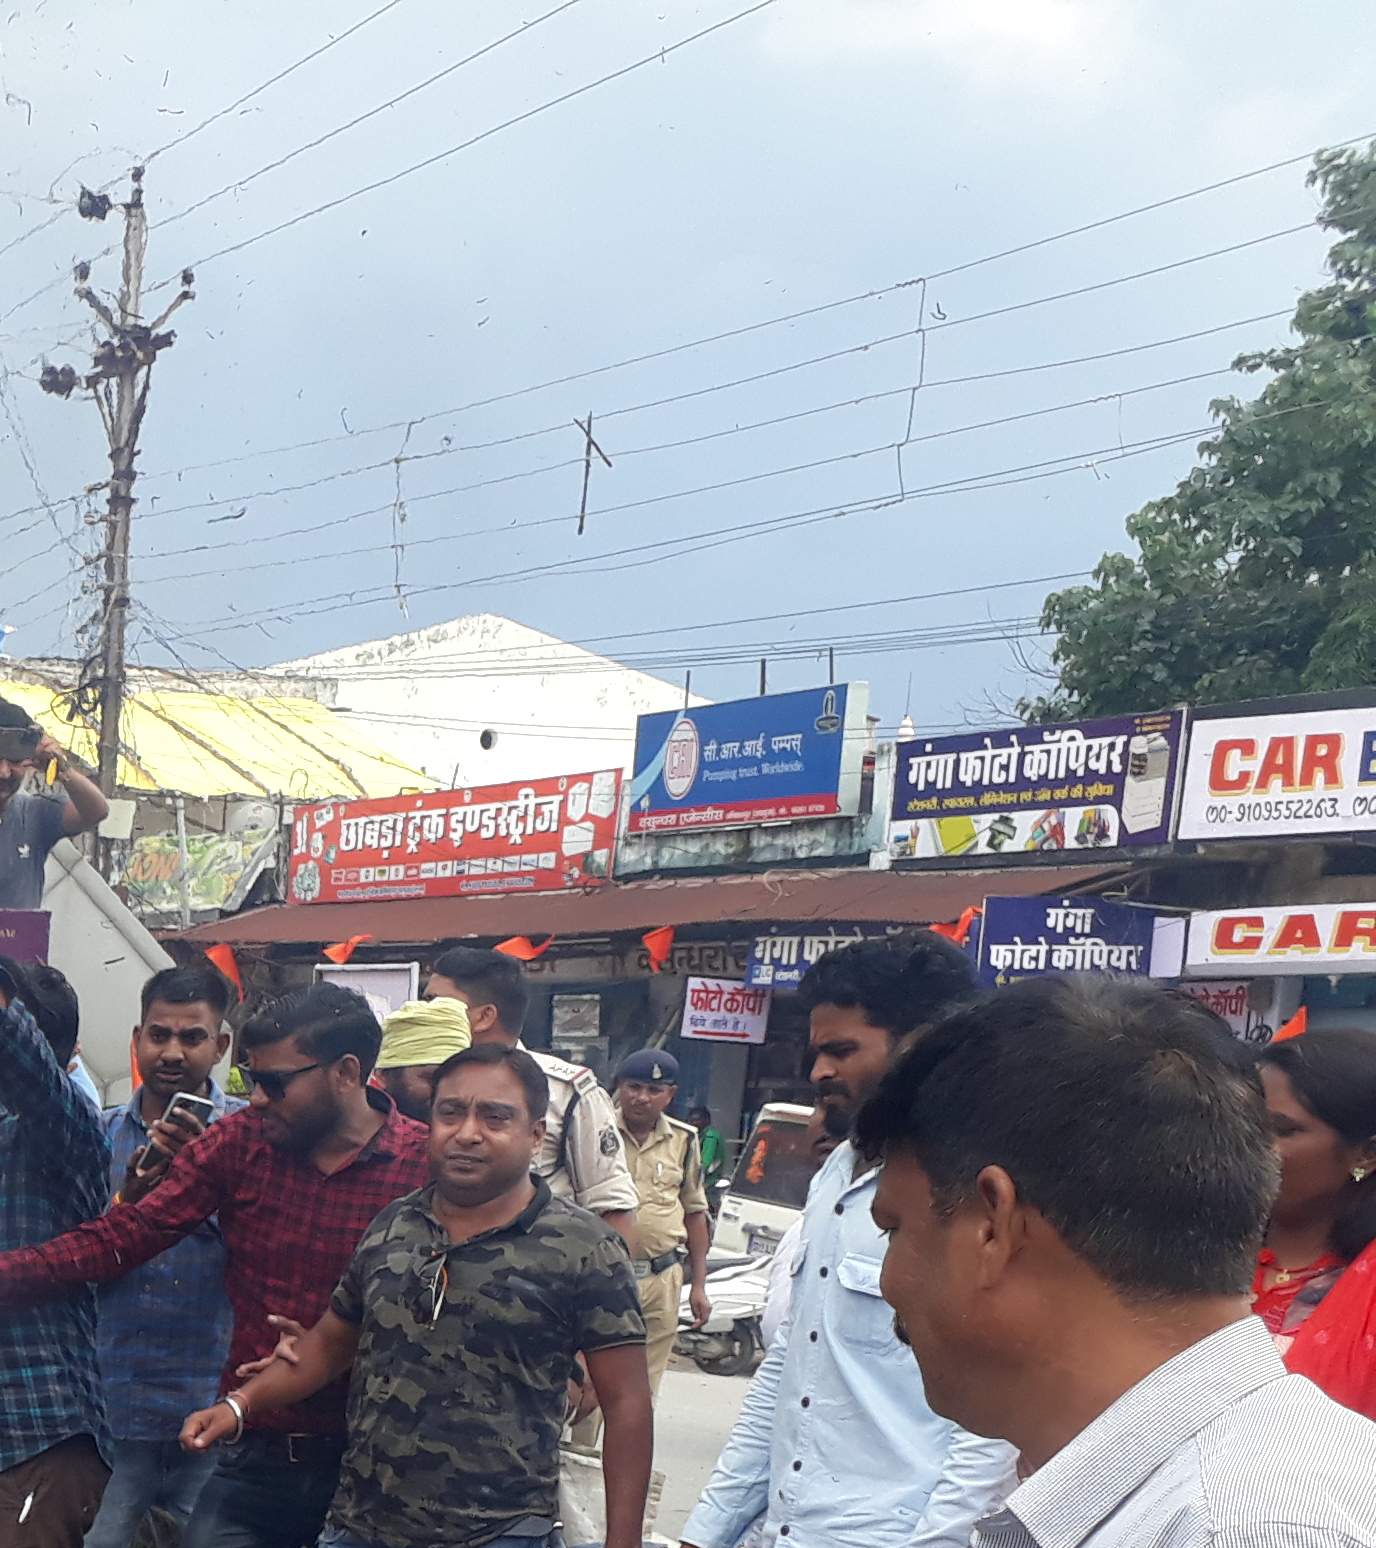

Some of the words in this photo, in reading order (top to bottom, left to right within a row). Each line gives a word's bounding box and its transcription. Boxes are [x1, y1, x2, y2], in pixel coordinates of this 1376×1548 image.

[908, 743, 957, 791] गंगा
[958, 735, 1024, 787] फोटो
[1024, 729, 1128, 781] कॉपियर
[1208, 733, 1345, 797] CAR
[339, 812, 407, 860] छाबड़ा
[406, 800, 448, 854] ट्रंक
[448, 787, 564, 848] इण्डस्ट्रीज
[1046, 899, 1095, 935] गंगा
[1210, 910, 1376, 955] CAR
[754, 926, 802, 965] गंगा
[989, 936, 1047, 970] फोटो
[1051, 936, 1144, 971] कॉपियर
[690, 981, 724, 1013] फोटो
[724, 986, 766, 1016] कॉपी
